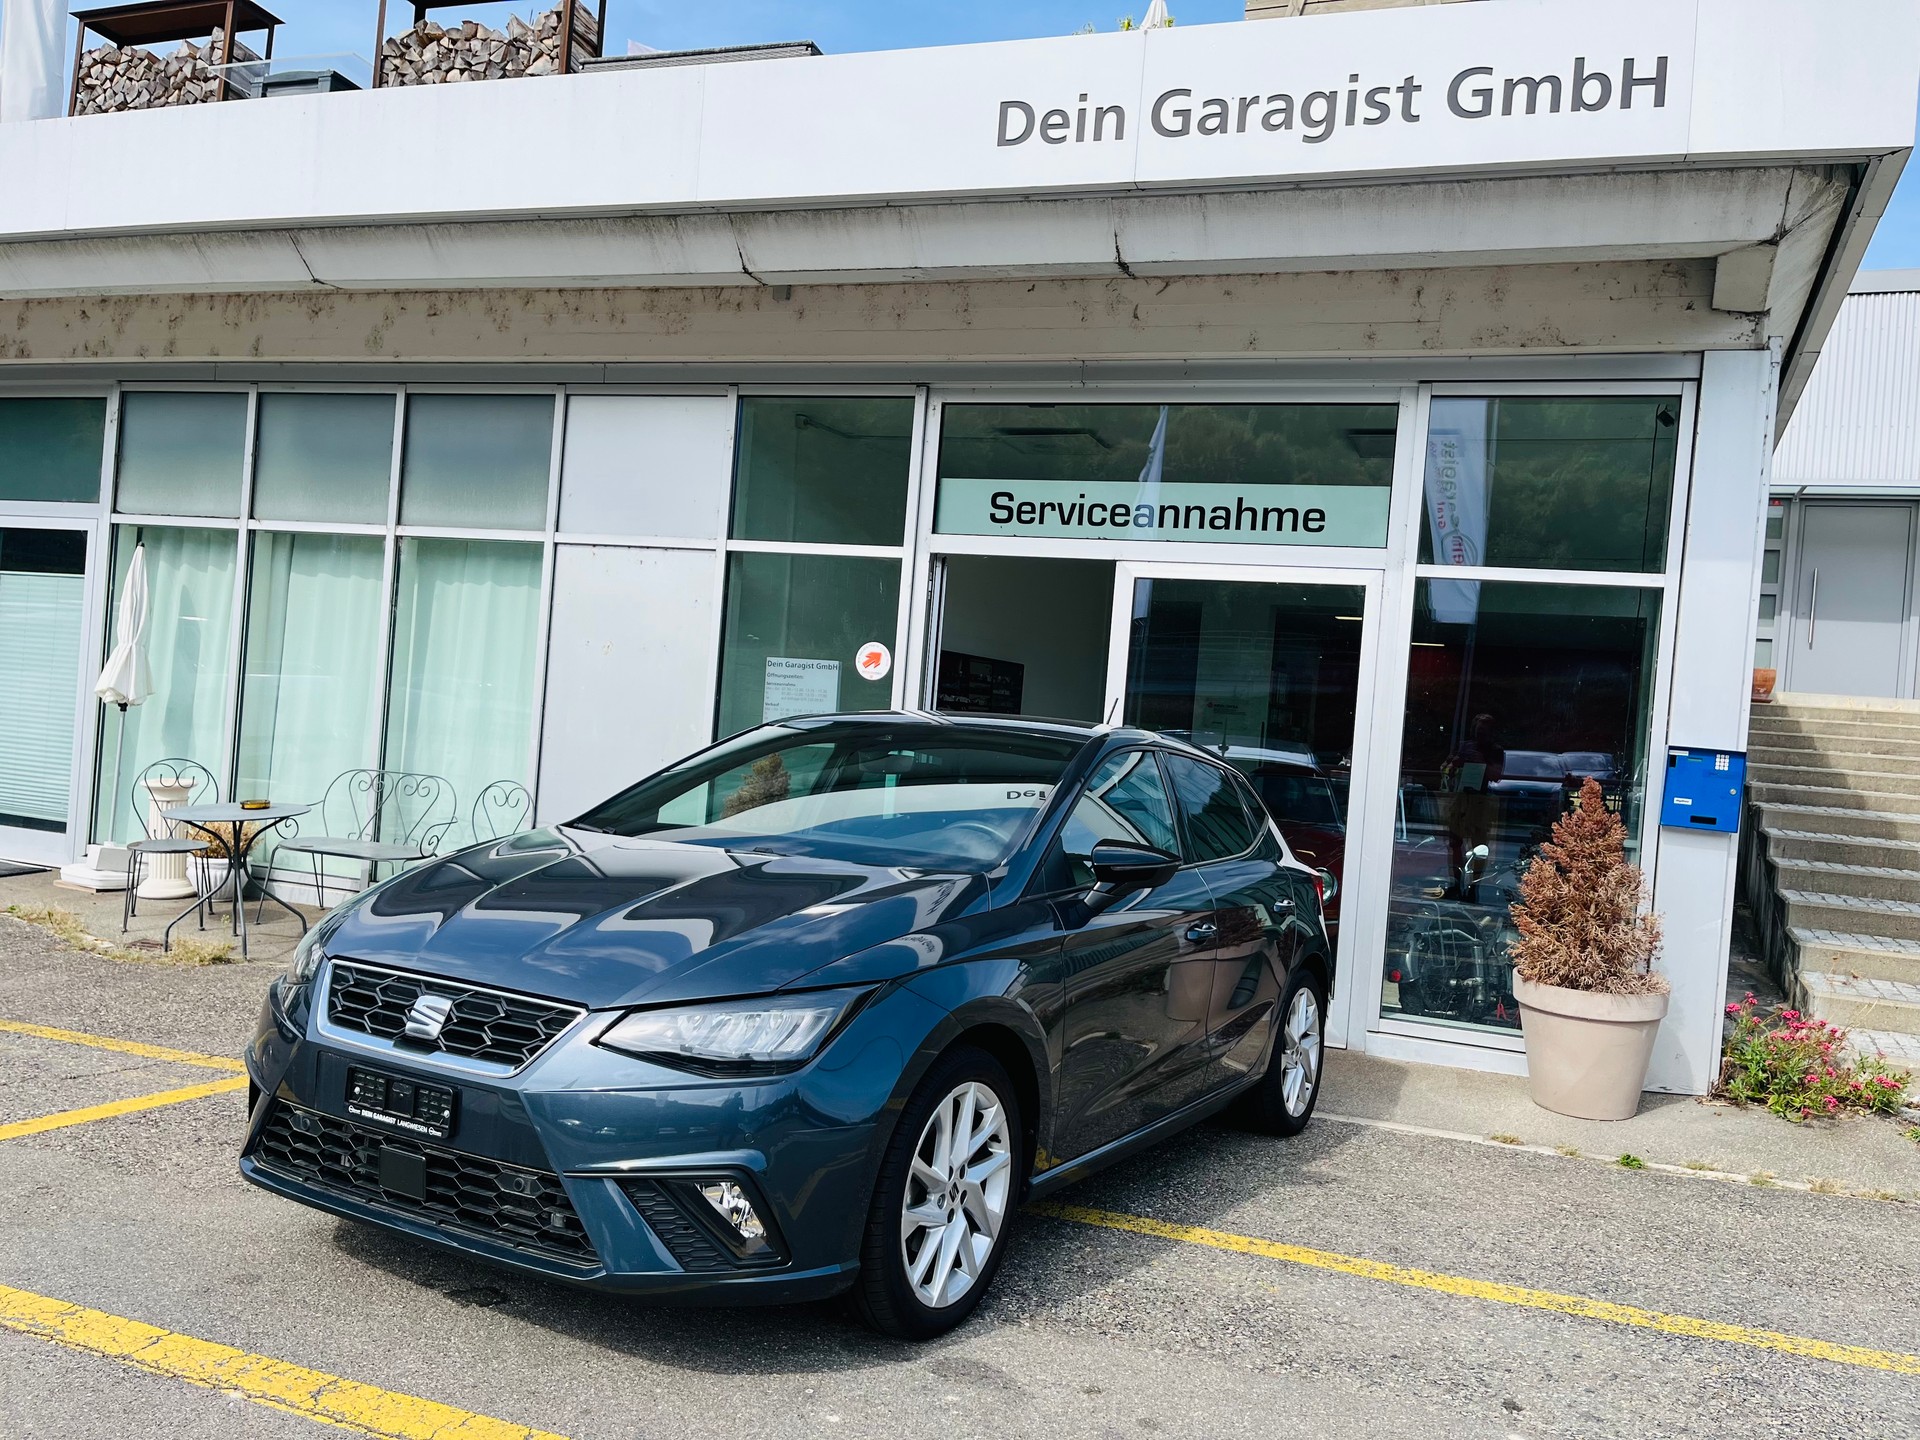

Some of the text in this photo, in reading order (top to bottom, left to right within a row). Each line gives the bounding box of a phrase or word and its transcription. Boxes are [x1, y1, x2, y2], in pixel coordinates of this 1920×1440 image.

[997, 56, 1668, 147] Dein Garagist GmbH
[989, 491, 1326, 533] Serviceannahme
[785, 662, 815, 670] Garagist
[373, 1112, 396, 1124] GARAGIST
[397, 1119, 427, 1132] LANGWIESEN
